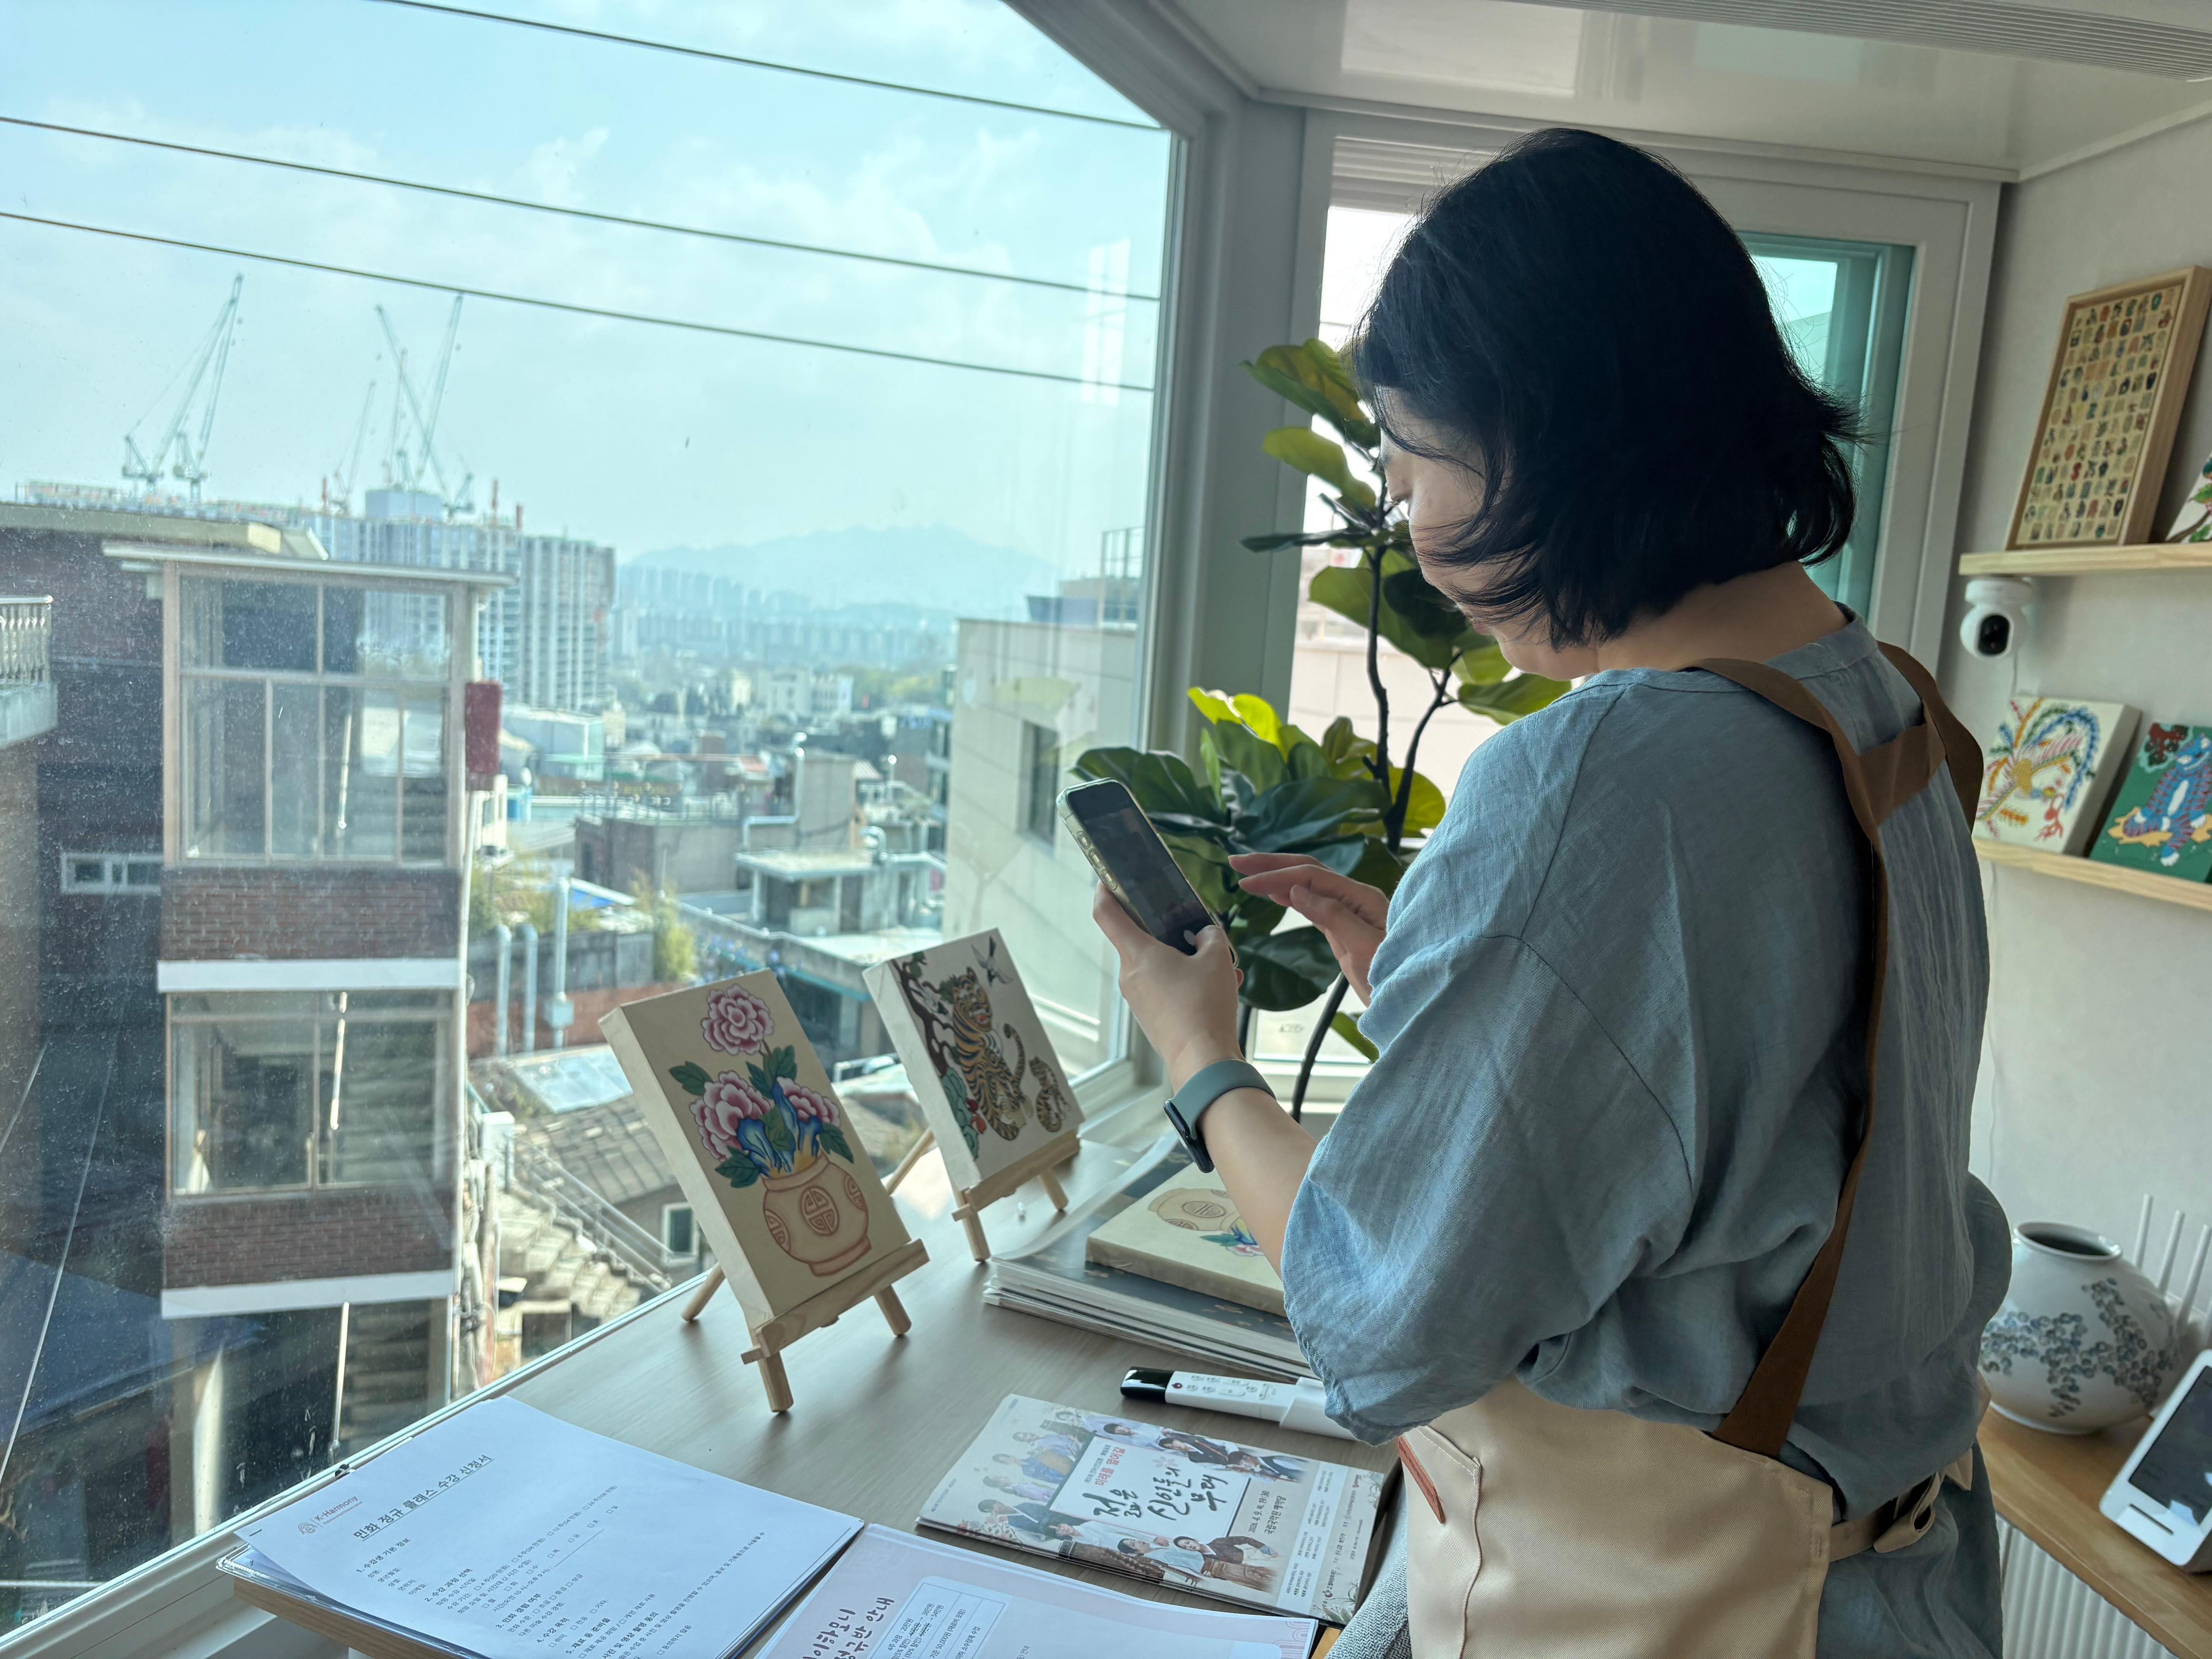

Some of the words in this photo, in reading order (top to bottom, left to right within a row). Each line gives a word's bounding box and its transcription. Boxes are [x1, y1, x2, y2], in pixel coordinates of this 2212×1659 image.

[1095, 1467, 1115, 1485] 미래를
[1106, 1447, 1125, 1465] 열어갈
[354, 1523, 380, 1539] 민화
[378, 1509, 404, 1523] 정규
[403, 1489, 438, 1509] 클래스
[438, 1474, 460, 1488] 수강
[459, 1455, 493, 1475] 신청서
[1082, 1488, 1143, 1518] 젊은
[1147, 1467, 1192, 1521] 신인들의
[1190, 1474, 1228, 1511] 무대
[1259, 1491, 1270, 1503] 19:30
[314, 1496, 357, 1521] K-Harmony
[1264, 1511, 1281, 1534] 국립국악원
[1274, 1496, 1286, 1510] 예악당
[364, 1555, 383, 1568] 수강생
[383, 1547, 397, 1555] 기본
[433, 1587, 445, 1596] 수강
[445, 1578, 459, 1587] 과정
[459, 1568, 472, 1577] 선택
[502, 1613, 517, 1623] 민화
[515, 1604, 529, 1613] 경험
[528, 1594, 541, 1602] 여부
[866, 1598, 895, 1621] 안내
[922, 1603, 934, 1616] 38만원
[508, 1624, 520, 1632] 민화
[543, 1628, 556, 1637] 수강
[555, 1618, 570, 1627] 목적
[571, 1638, 586, 1648] 재료
[591, 1618, 610, 1632] 준비물
[584, 1644, 596, 1653] 재료
[595, 1636, 606, 1644] 제공
[605, 1627, 617, 1635] 희망
[624, 1610, 636, 1619] 개인
[603, 1649, 616, 1659] 사진
[621, 1633, 634, 1642] 영상
[633, 1622, 646, 1632] 촬영
[644, 1612, 659, 1621] 동의
[630, 1642, 641, 1650] 수업
[646, 1628, 657, 1637] 사진
[662, 1634, 683, 1649] 동의하지
[803, 1609, 855, 1659] 이하모니
[892, 1635, 902, 1643] 과정
[900, 1618, 914, 1631] 20만원
[904, 1648, 915, 1658] (10%
[931, 1605, 944, 1617] 54만원
[930, 1650, 940, 1658] 기준
[936, 1632, 951, 1650] 50,000원
[946, 1618, 960, 1632] (재료비
[955, 1609, 966, 1618] 포함)
[961, 1635, 975, 1651] 소수정예
[971, 1626, 981, 1635] 수업
[1020, 1645, 1031, 1654] 안내
